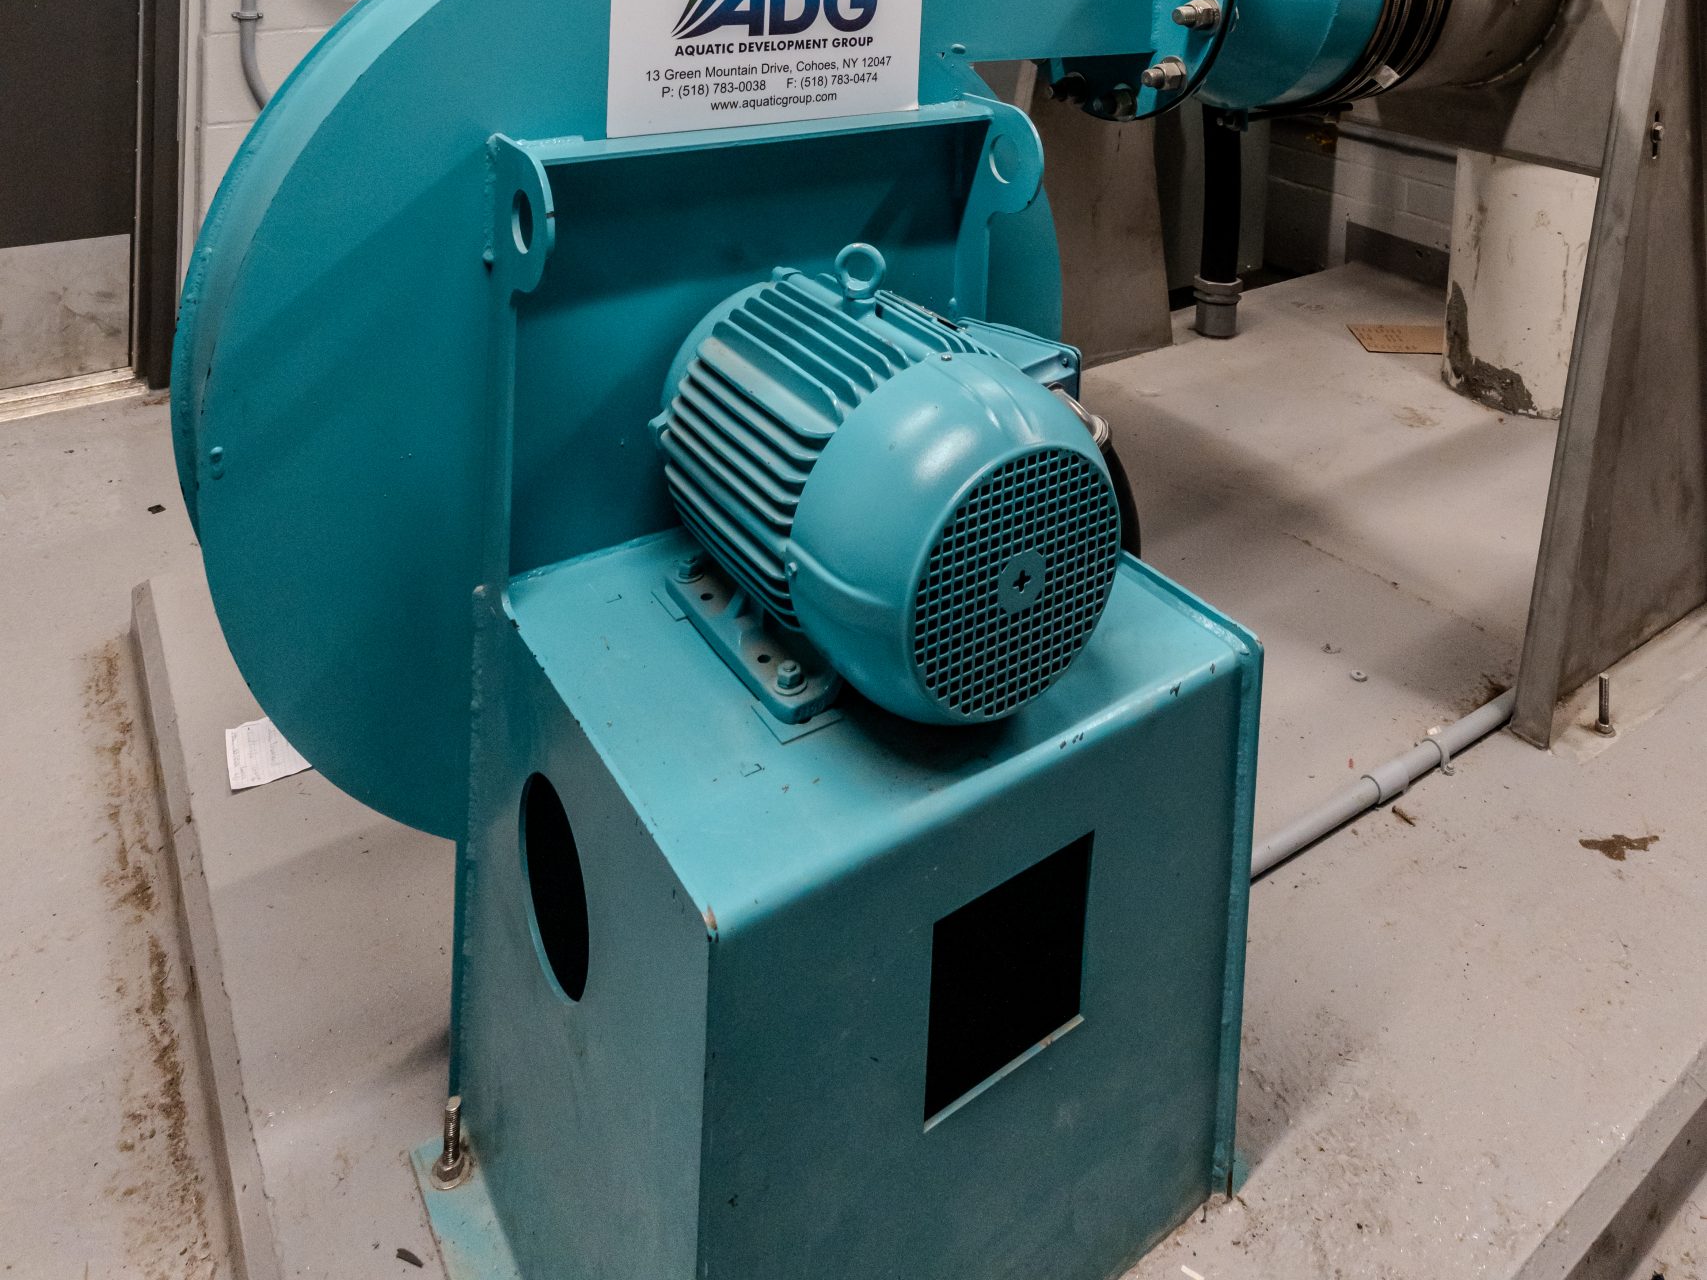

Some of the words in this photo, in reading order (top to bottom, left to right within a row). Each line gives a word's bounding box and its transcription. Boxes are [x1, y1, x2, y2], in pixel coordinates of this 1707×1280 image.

[674, 42, 734, 57] AQUATIC
[738, 38, 829, 54] DEVELOPMENT
[832, 36, 874, 49] GROUP
[646, 70, 660, 82] 13
[664, 68, 701, 81] Green
[705, 64, 758, 79] Mountain
[761, 62, 793, 75] Drive,
[796, 60, 840, 72] Cohoes,
[842, 57, 859, 70] NY
[862, 55, 892, 68] 12047
[661, 86, 674, 98] P:
[678, 83, 710, 100] (518)
[713, 79, 766, 95] 783-0038
[786, 77, 797, 89] F:
[800, 75, 828, 90] (518)
[831, 71, 878, 86] 783-0474
[710, 92, 837, 111] www.aquaticgroup.com
